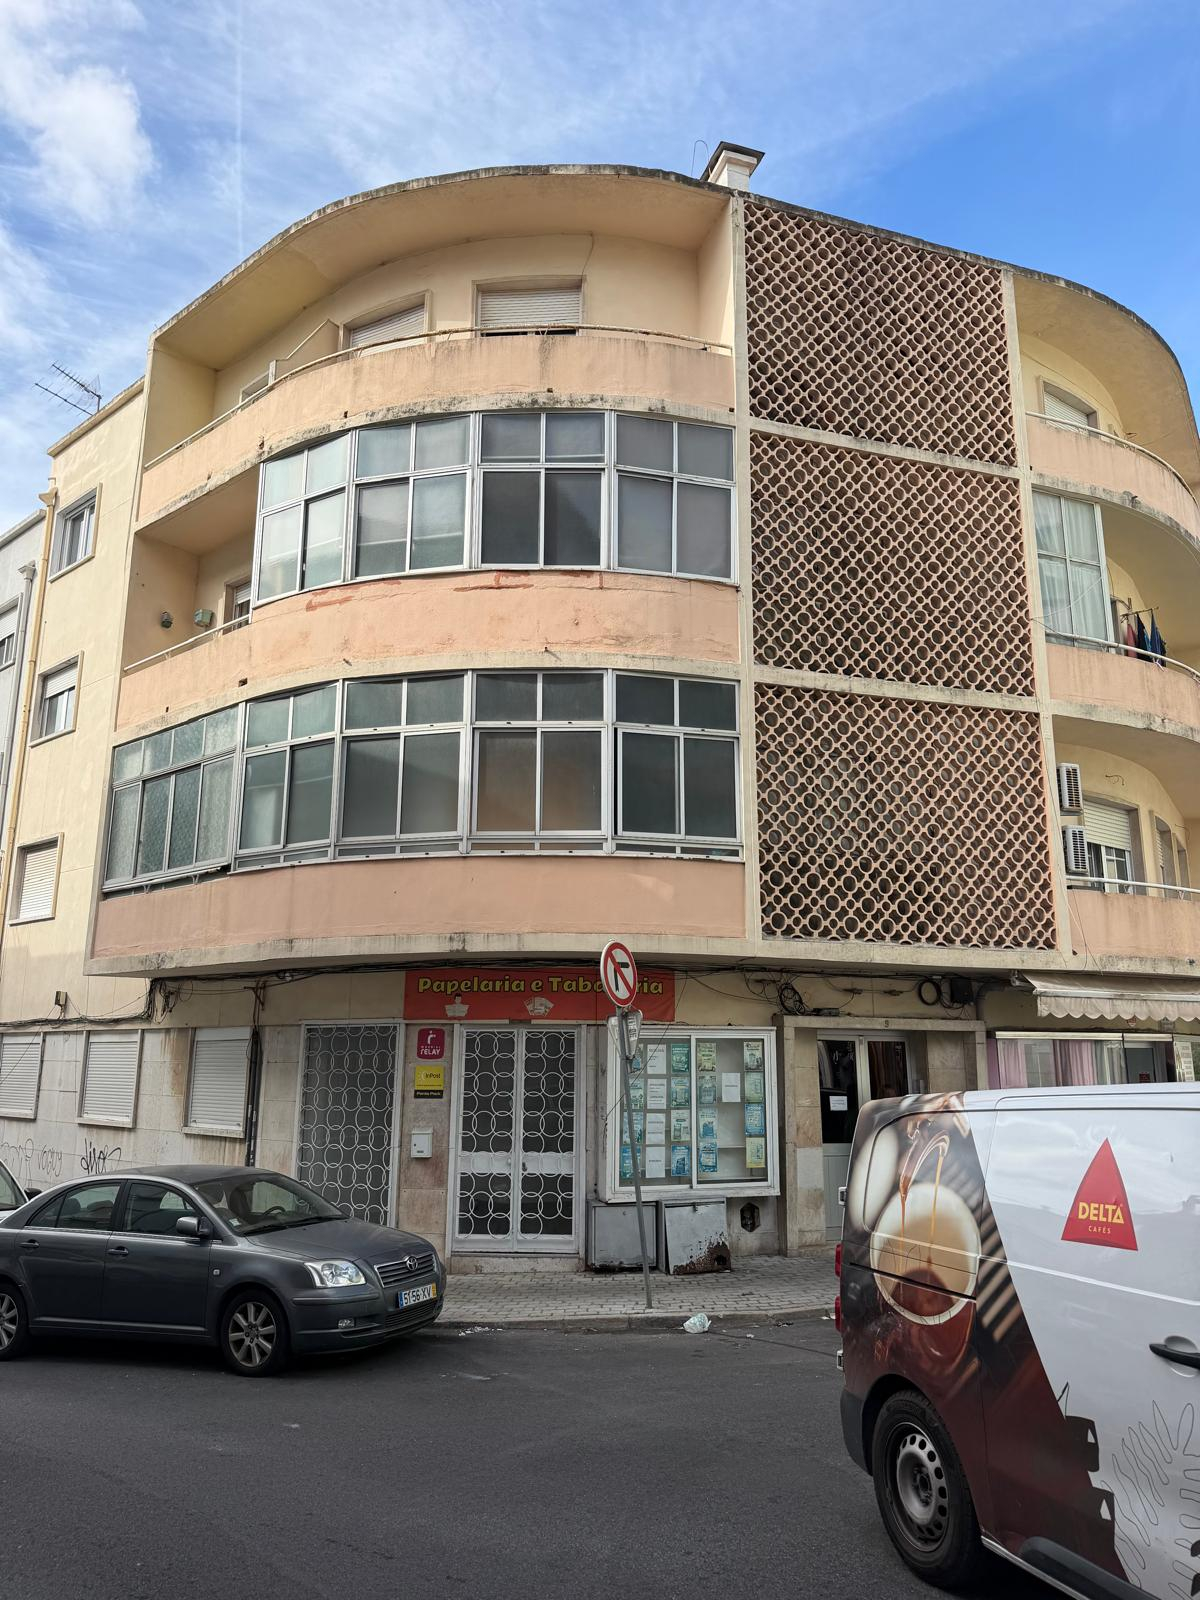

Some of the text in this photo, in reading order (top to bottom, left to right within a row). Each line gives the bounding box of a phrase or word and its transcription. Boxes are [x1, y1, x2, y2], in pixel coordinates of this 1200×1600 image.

[418, 976, 663, 996] Papelaria e Tabaria
[1078, 1202, 1125, 1224] DELTA
